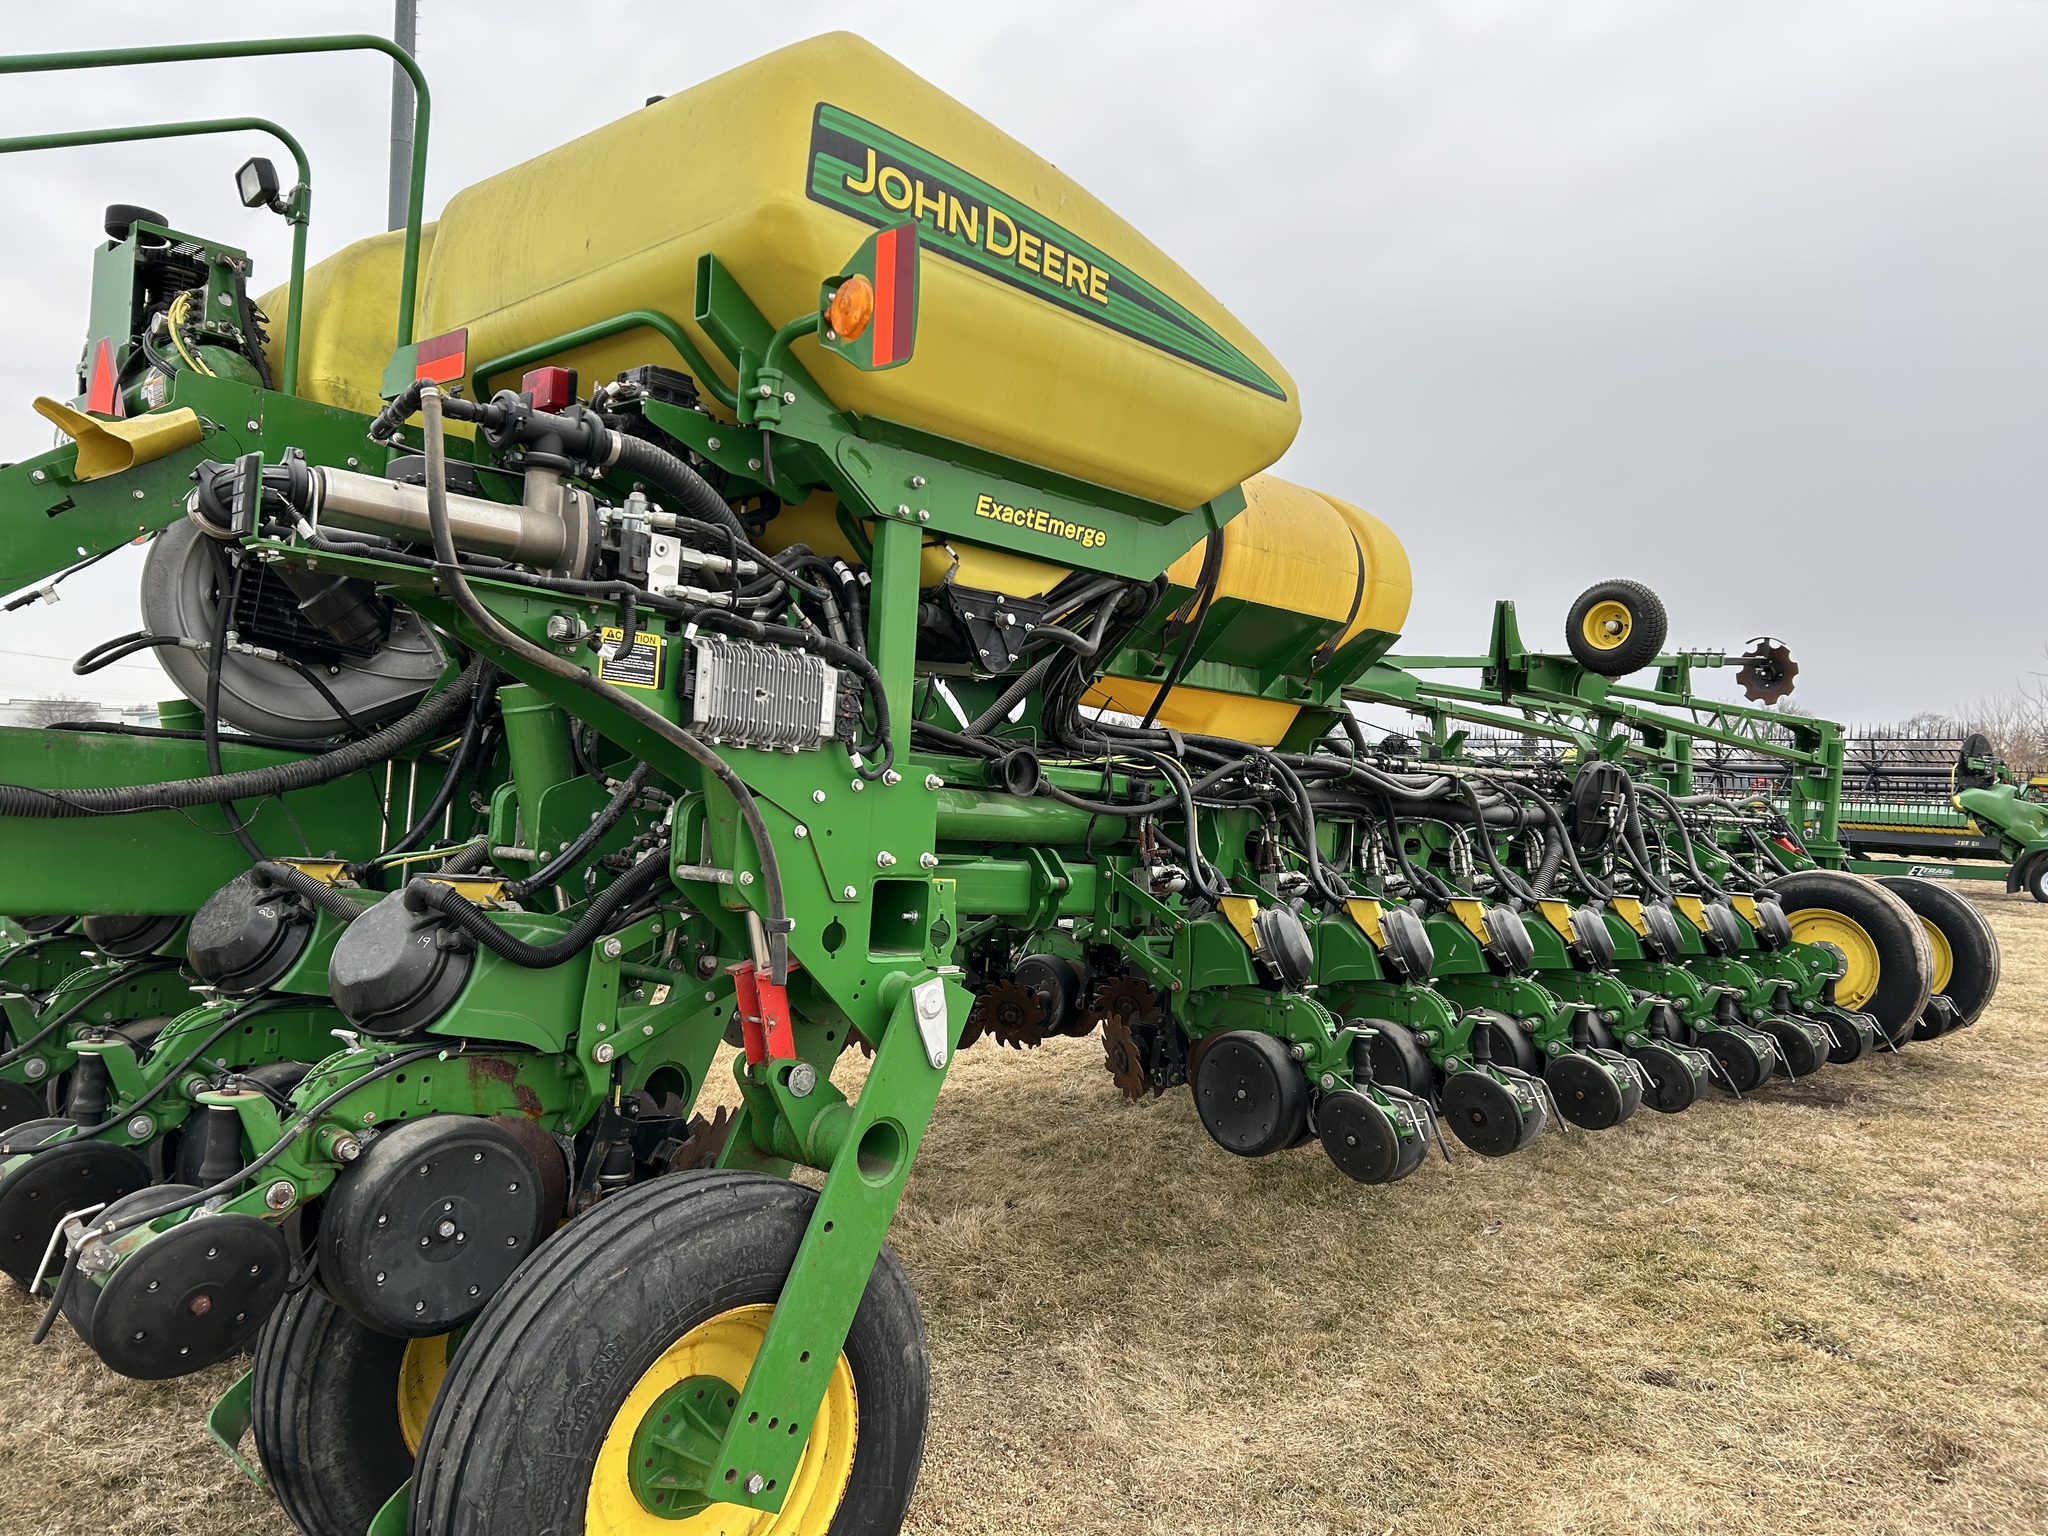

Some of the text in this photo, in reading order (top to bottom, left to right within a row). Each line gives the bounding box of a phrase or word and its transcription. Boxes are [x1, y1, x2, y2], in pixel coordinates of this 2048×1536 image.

[846, 148, 1110, 304] JOHN DEERE
[975, 493, 1107, 548] ExactEmerge
[615, 631, 657, 644] CTION
[417, 934, 432, 949] 19
